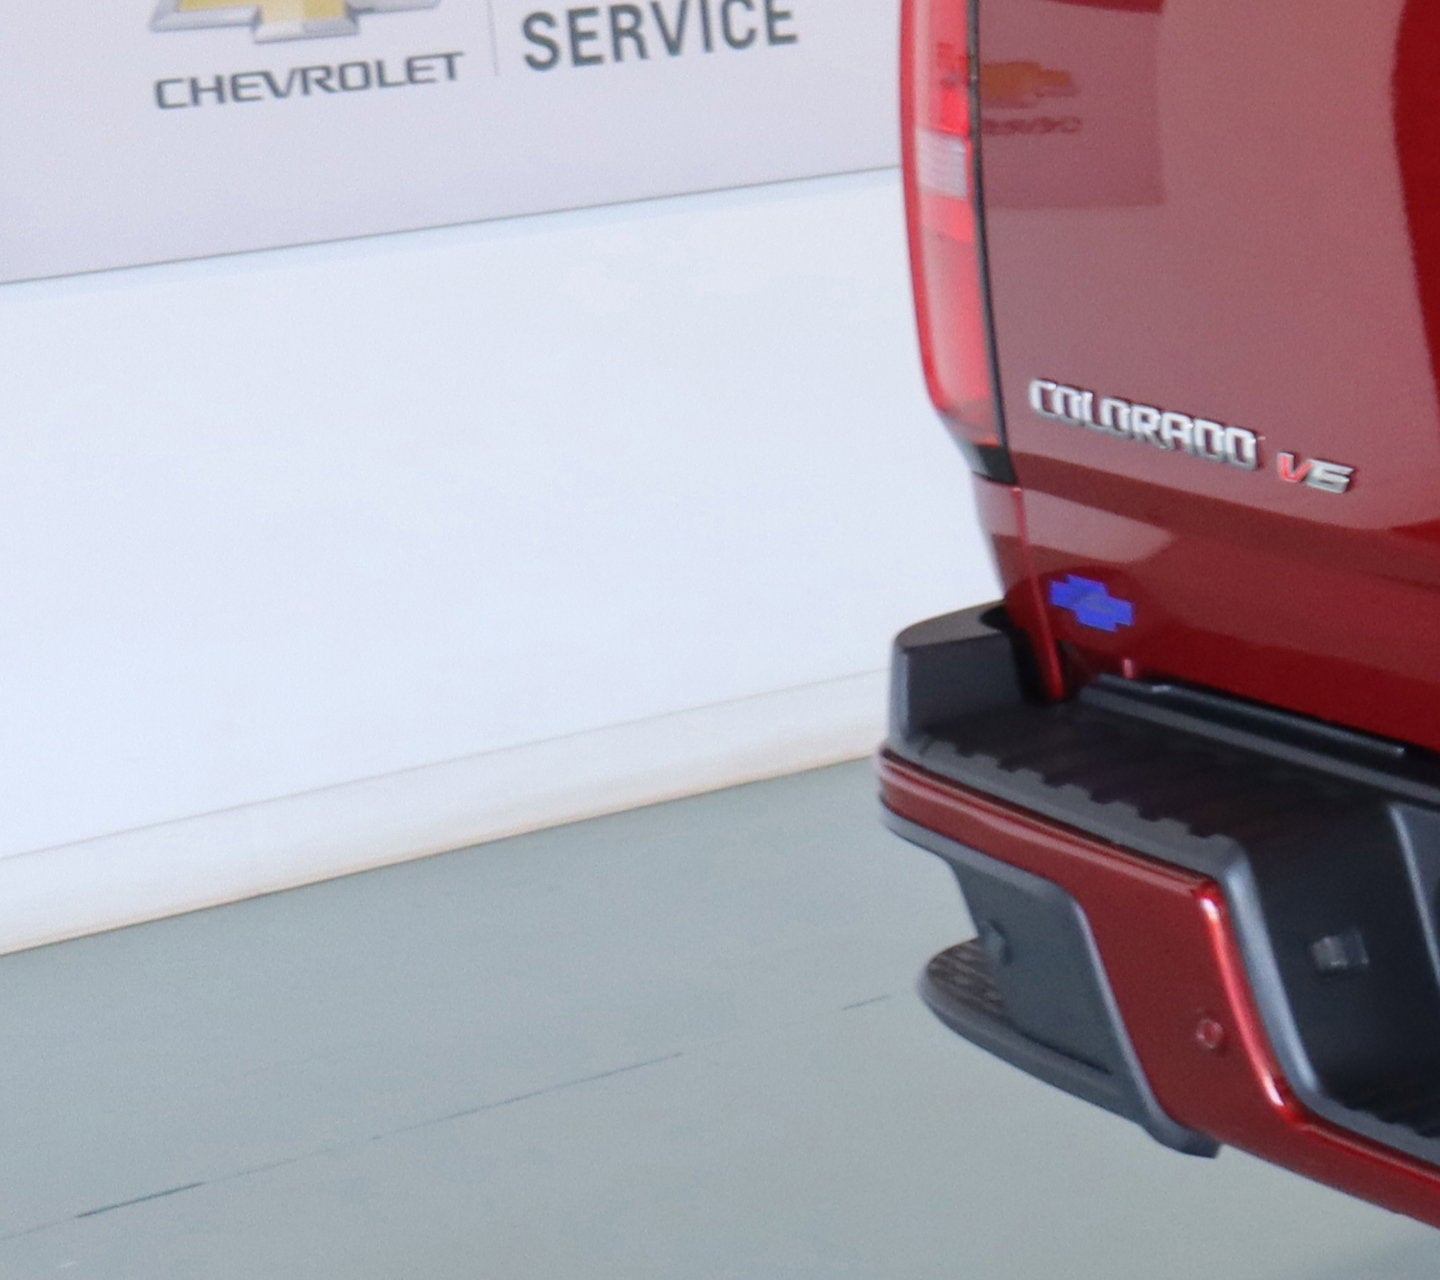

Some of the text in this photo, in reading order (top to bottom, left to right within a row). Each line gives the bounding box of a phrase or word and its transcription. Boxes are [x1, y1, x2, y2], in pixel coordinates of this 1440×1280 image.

[154, 51, 466, 110] CHEVROLET
[1029, 378, 1354, 494] COLORADO V6
